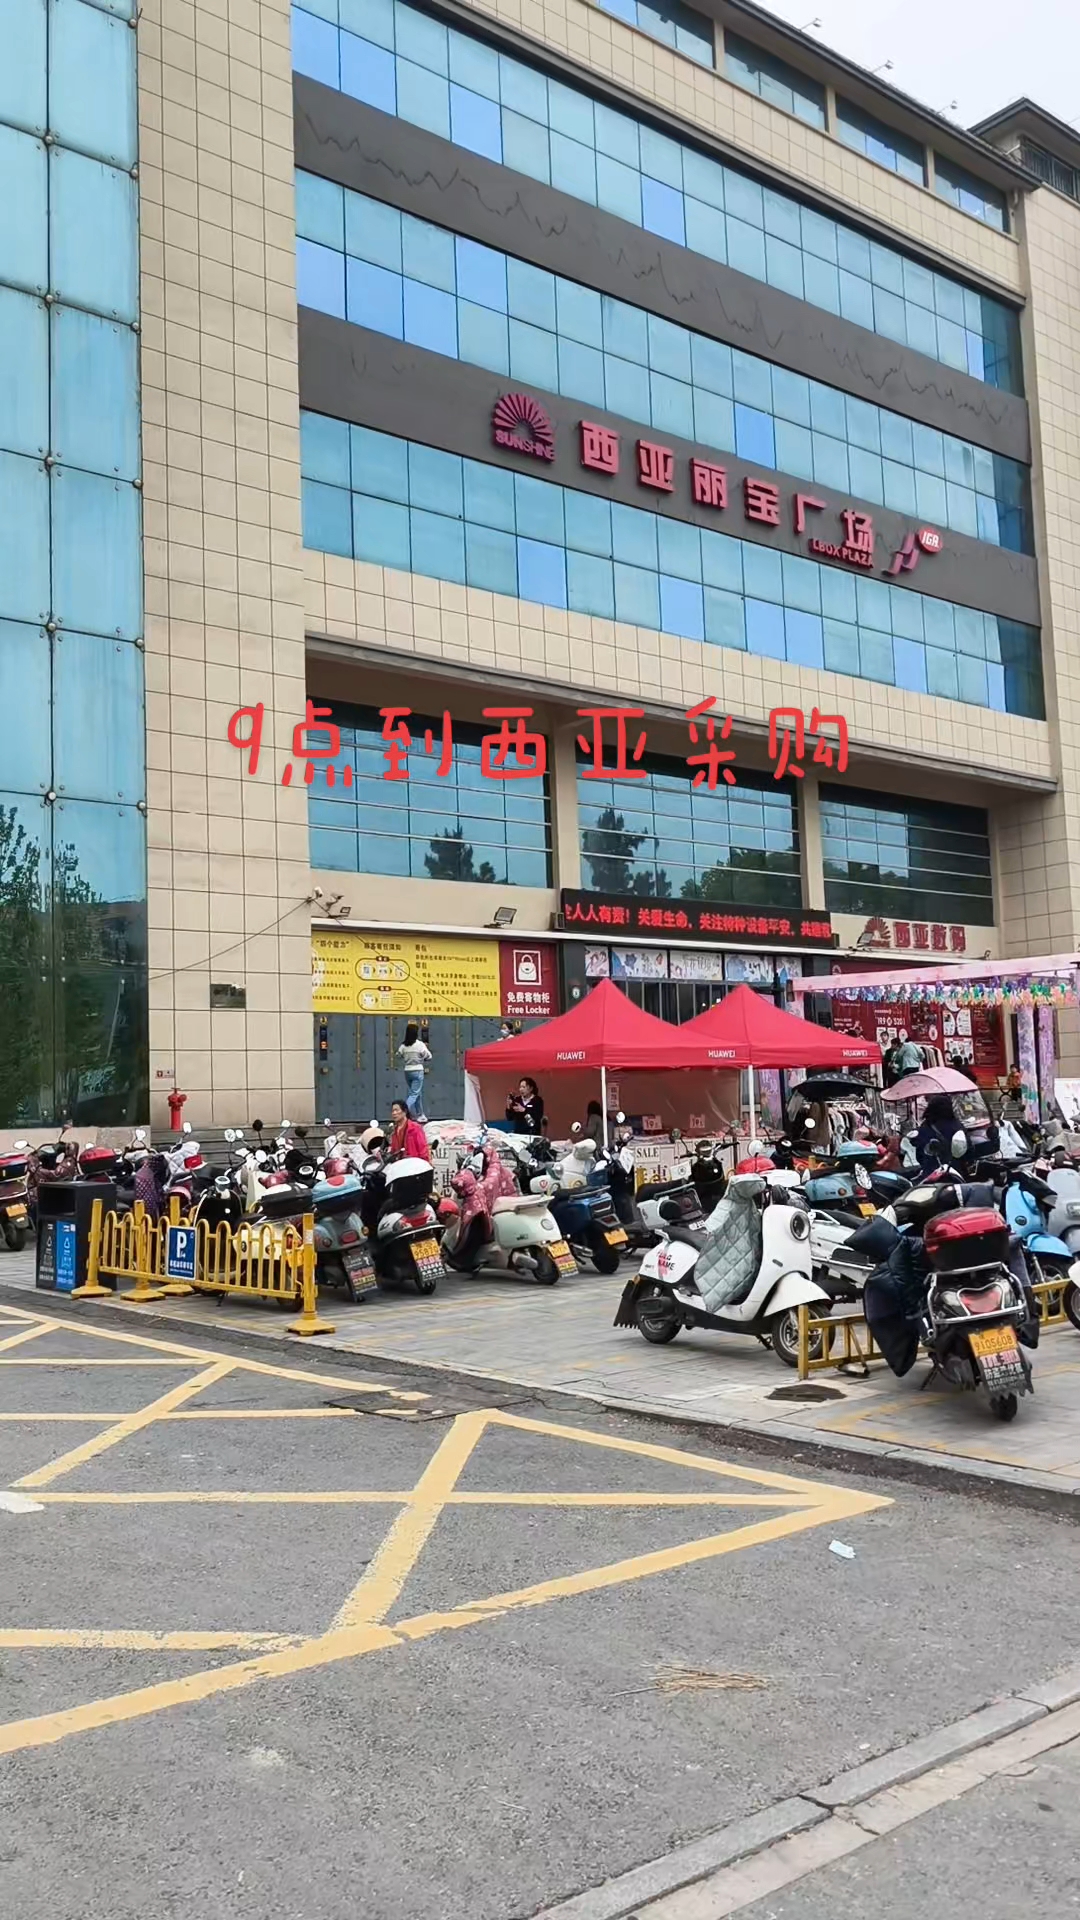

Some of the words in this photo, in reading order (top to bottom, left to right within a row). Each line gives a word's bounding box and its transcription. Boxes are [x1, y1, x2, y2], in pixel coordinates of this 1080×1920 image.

[494, 429, 555, 462] SUNSHINE
[580, 419, 875, 554] 西亚丽宝广场
[921, 531, 940, 548] IGA
[842, 549, 875, 567] PLAZA
[507, 991, 551, 1004] 免费寄物柜
[507, 1005, 525, 1014] Free
[525, 1005, 551, 1015] Locker
[557, 1051, 586, 1061] HUAWEI
[708, 1050, 736, 1059] HUAWEI
[842, 1049, 869, 1058] HUAWEI
[636, 1147, 660, 1159] SALE
[176, 1231, 187, 1259] P
